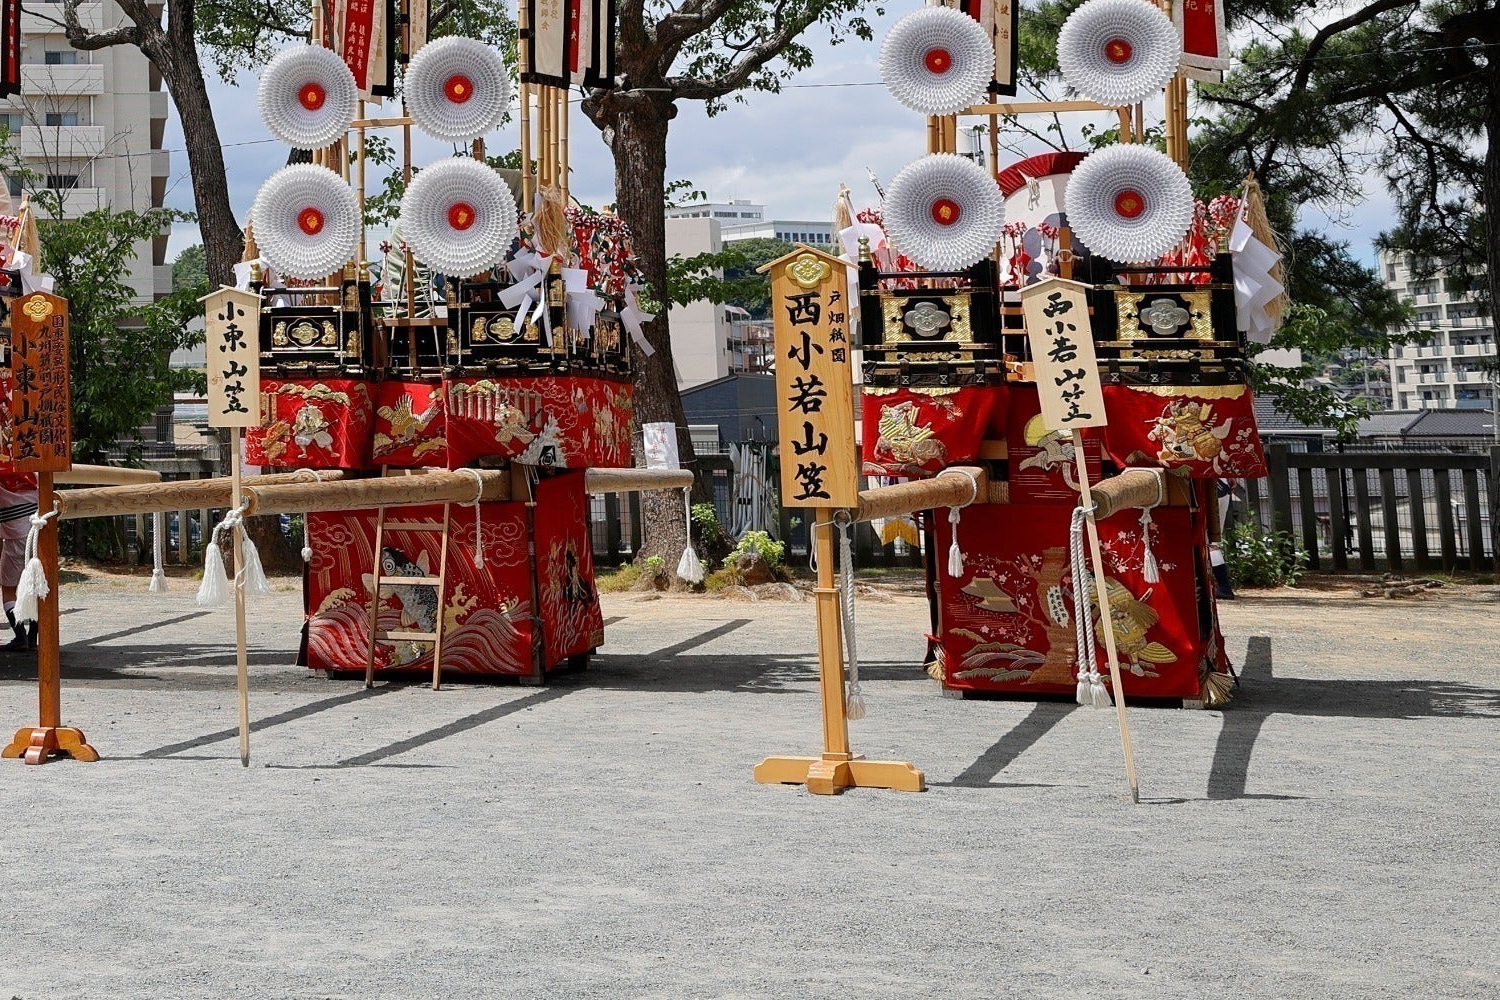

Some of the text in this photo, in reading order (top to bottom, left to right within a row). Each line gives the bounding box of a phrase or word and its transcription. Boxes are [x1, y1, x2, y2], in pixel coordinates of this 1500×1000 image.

[39, 325, 53, 445] 九州筑前戸畑祇園
[52, 315, 66, 458] 国重要無形民俗文化財
[218, 301, 249, 414] 小東山笠
[828, 291, 846, 364] 戸畑祇園
[1043, 292, 1092, 422] 西小若山笠
[13, 332, 40, 461] 小東山笠
[785, 291, 831, 501] 西小若山笠
